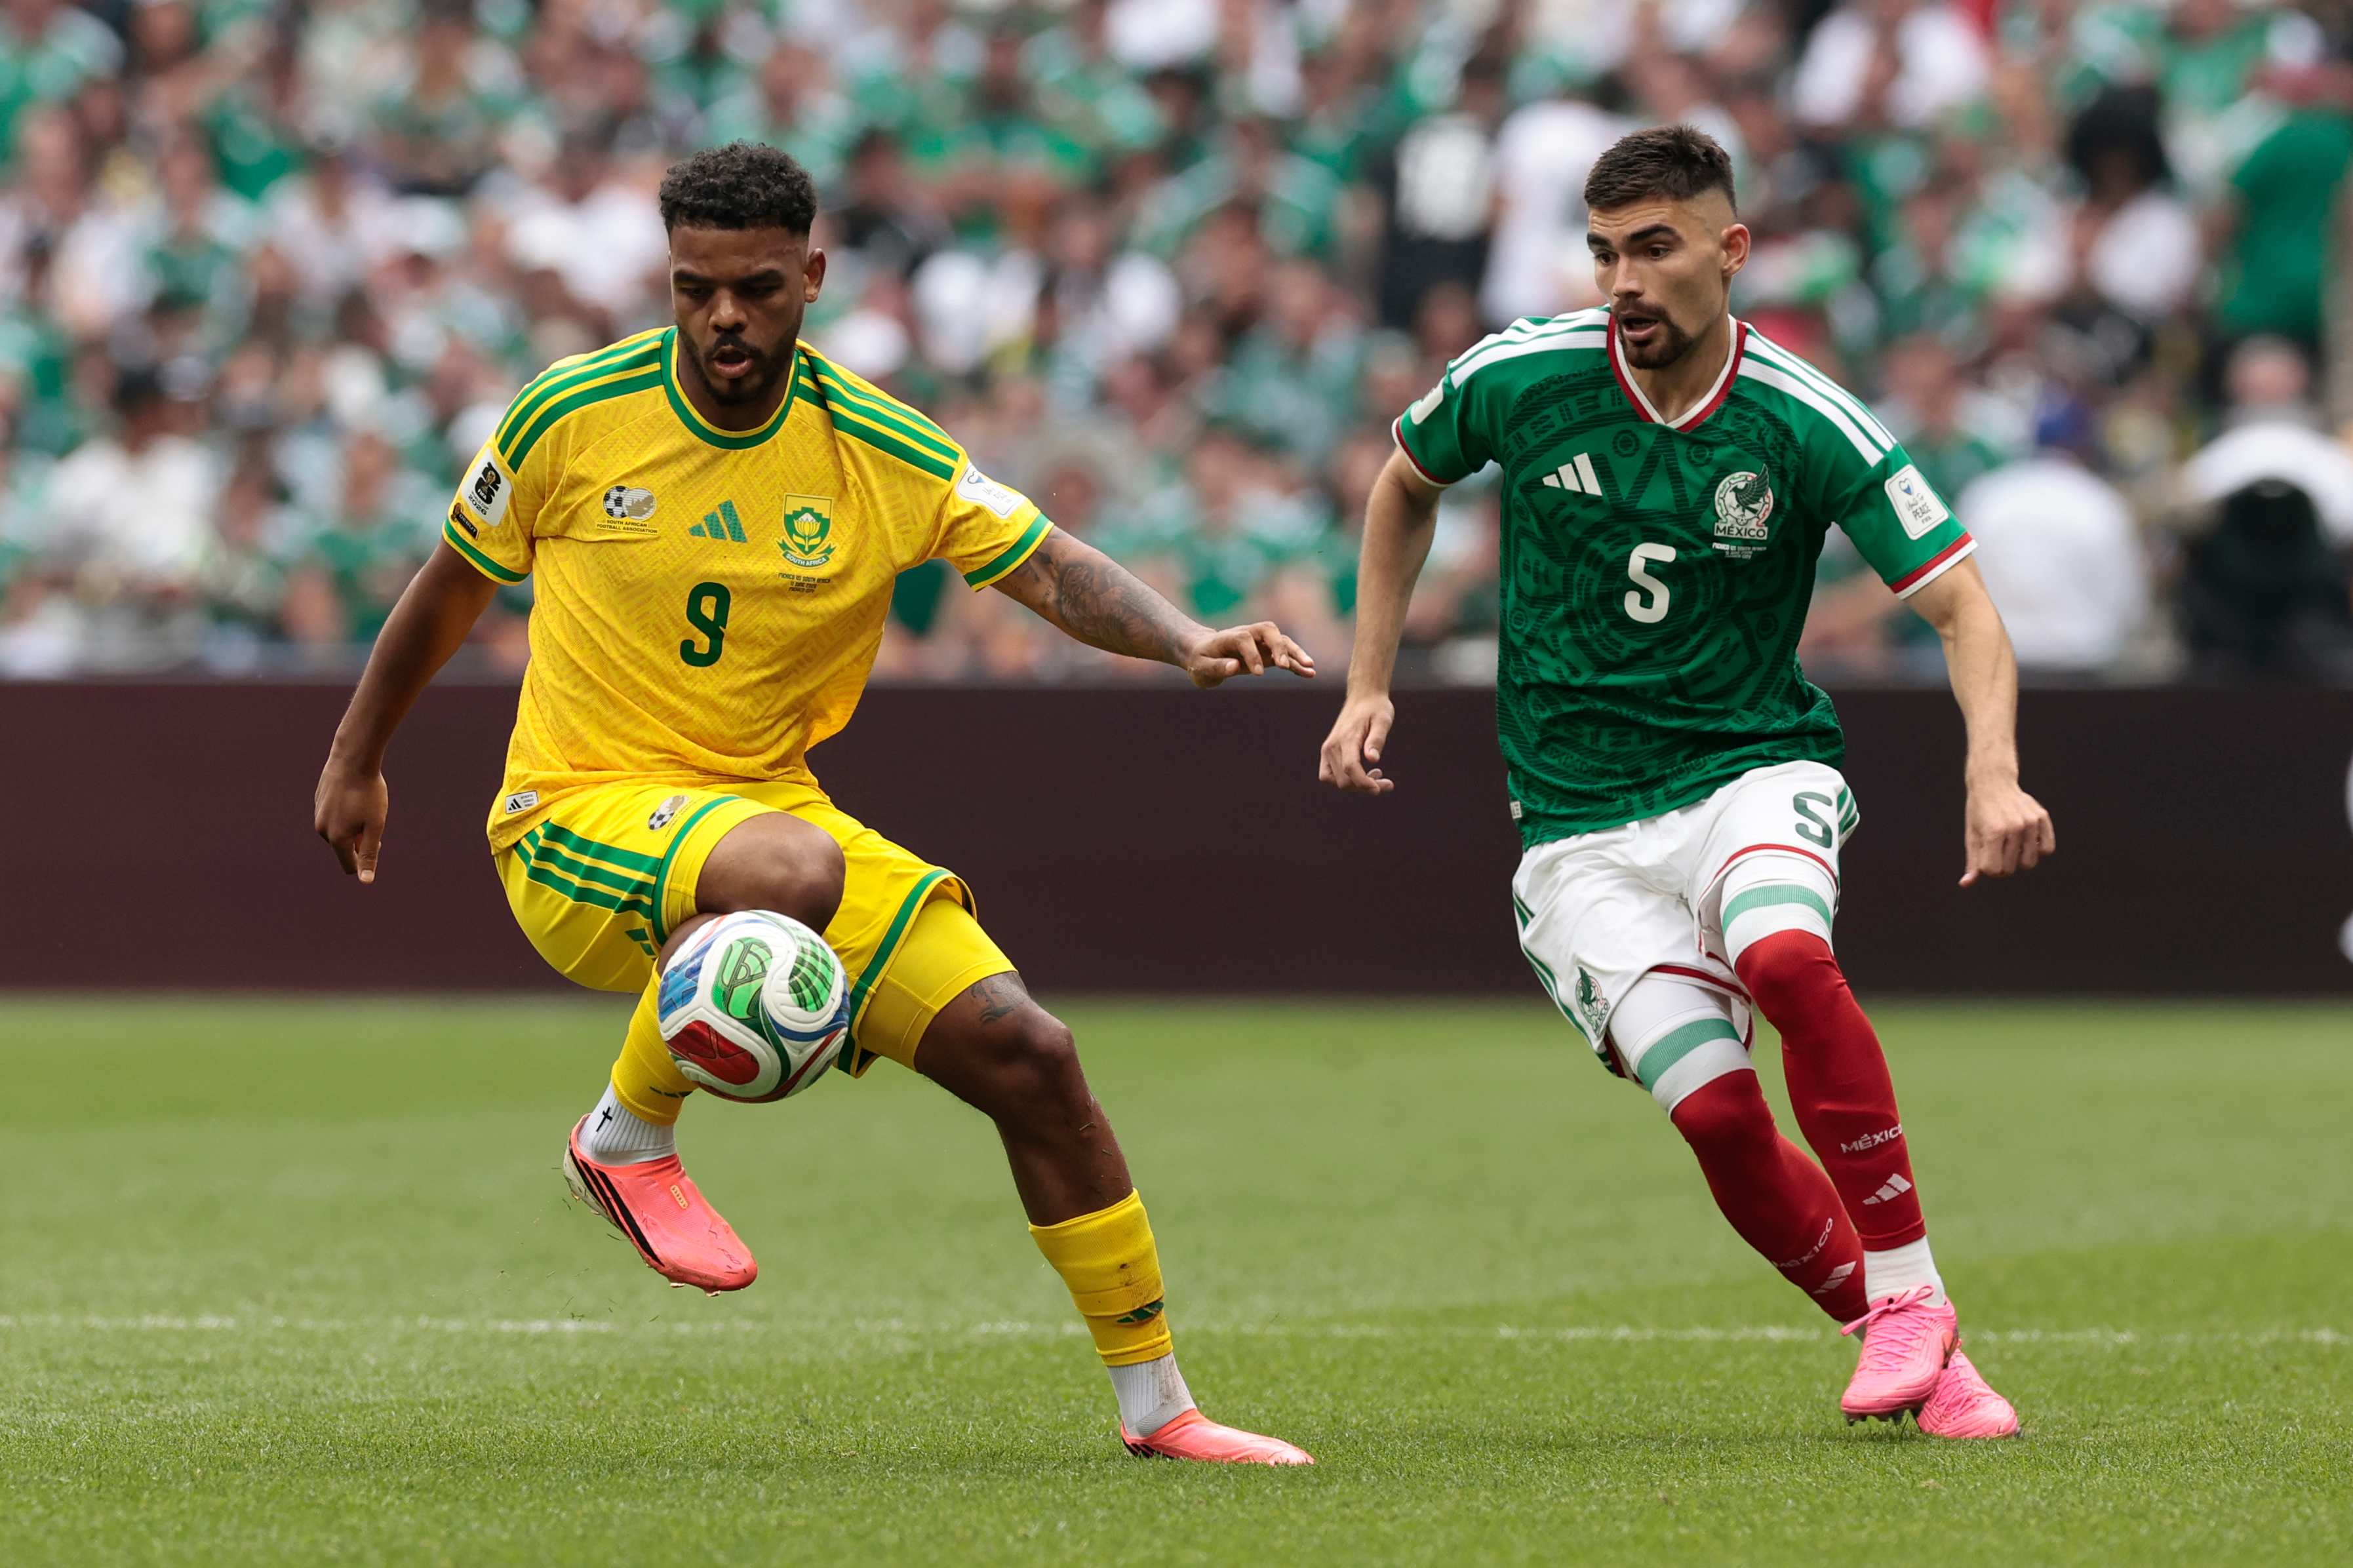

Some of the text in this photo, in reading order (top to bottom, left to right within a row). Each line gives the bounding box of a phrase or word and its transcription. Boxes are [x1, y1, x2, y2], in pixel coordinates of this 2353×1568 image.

[468, 494, 487, 515] 2026
[459, 513, 477, 532] DEBUT
[1716, 524, 1766, 538] MÉXICO
[786, 553, 827, 566] SOUTH AFRICA
[1624, 542, 1676, 623] 5
[680, 582, 731, 667] 9
[1792, 791, 1832, 849] 5
